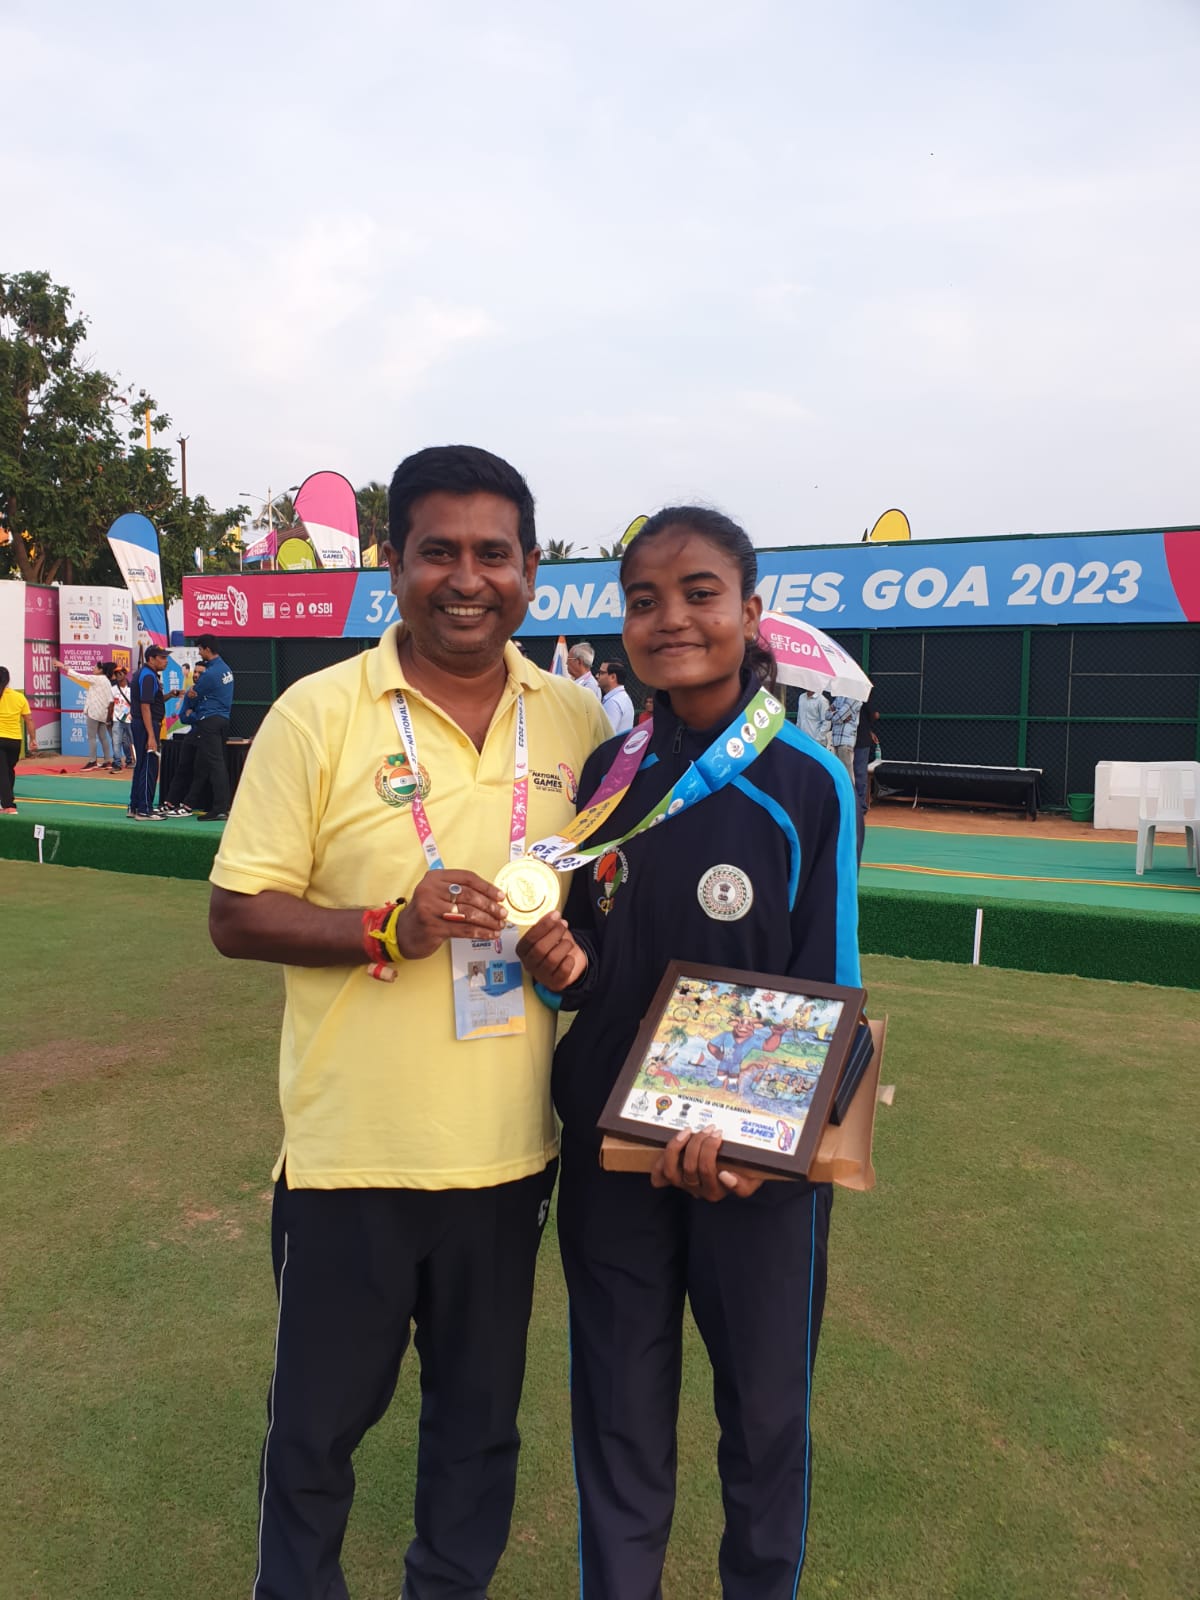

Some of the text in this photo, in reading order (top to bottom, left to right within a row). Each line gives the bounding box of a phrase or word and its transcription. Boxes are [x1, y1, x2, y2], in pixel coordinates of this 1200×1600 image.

[862, 566, 990, 611] GOA
[1007, 560, 1142, 606] 2023
[196, 593, 227, 601] NATIONAL
[197, 600, 230, 610] GAMES
[317, 602, 333, 614] SBI
[770, 633, 791, 644] GET
[790, 641, 822, 658] GOA
[33, 674, 52, 690] ONE
[399, 704, 415, 746] NATIONAL
[71, 728, 83, 737] 28
[532, 771, 561, 780] NATIONAL
[533, 778, 563, 789] GAMES
[741, 1126, 775, 1138] GAMES
